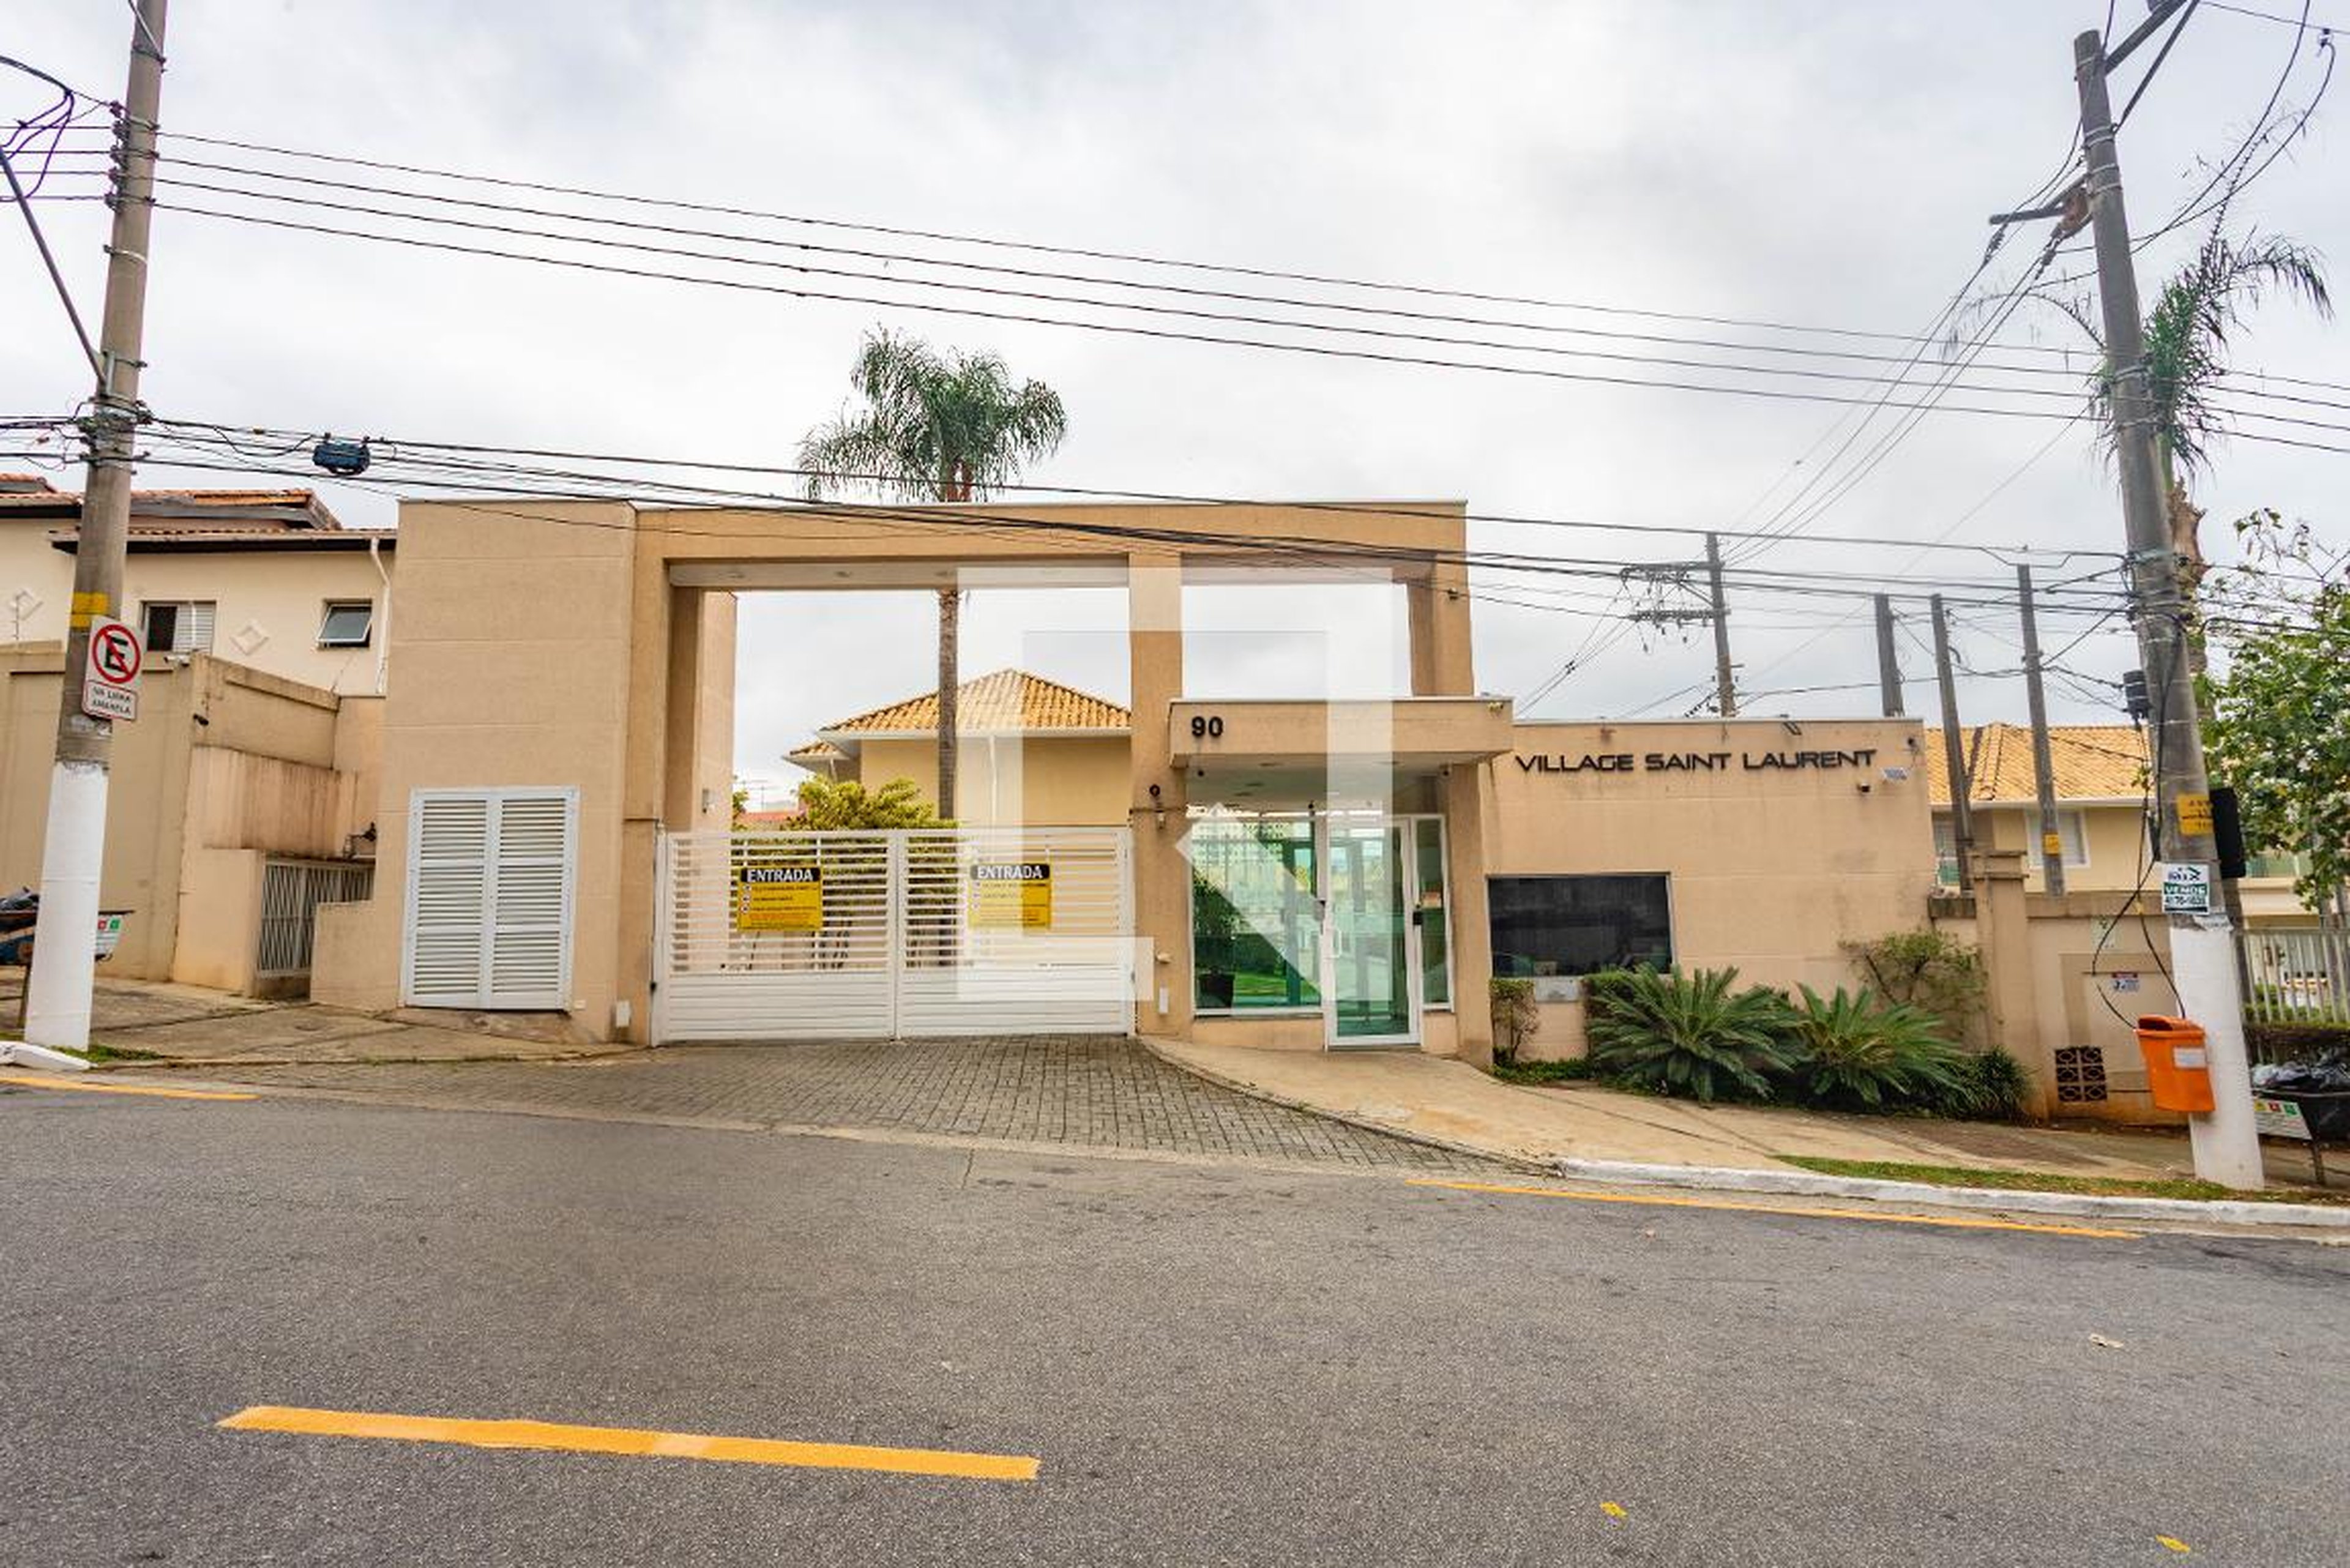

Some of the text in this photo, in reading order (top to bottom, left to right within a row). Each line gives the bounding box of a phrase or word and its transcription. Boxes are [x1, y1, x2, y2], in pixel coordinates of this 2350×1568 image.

[1192, 715, 1223, 737] 90
[1515, 749, 1878, 772] VILLAGE SAINT LAURENT
[746, 868, 814, 883] ENTRADA
[977, 865, 1043, 879] ENTRADA
